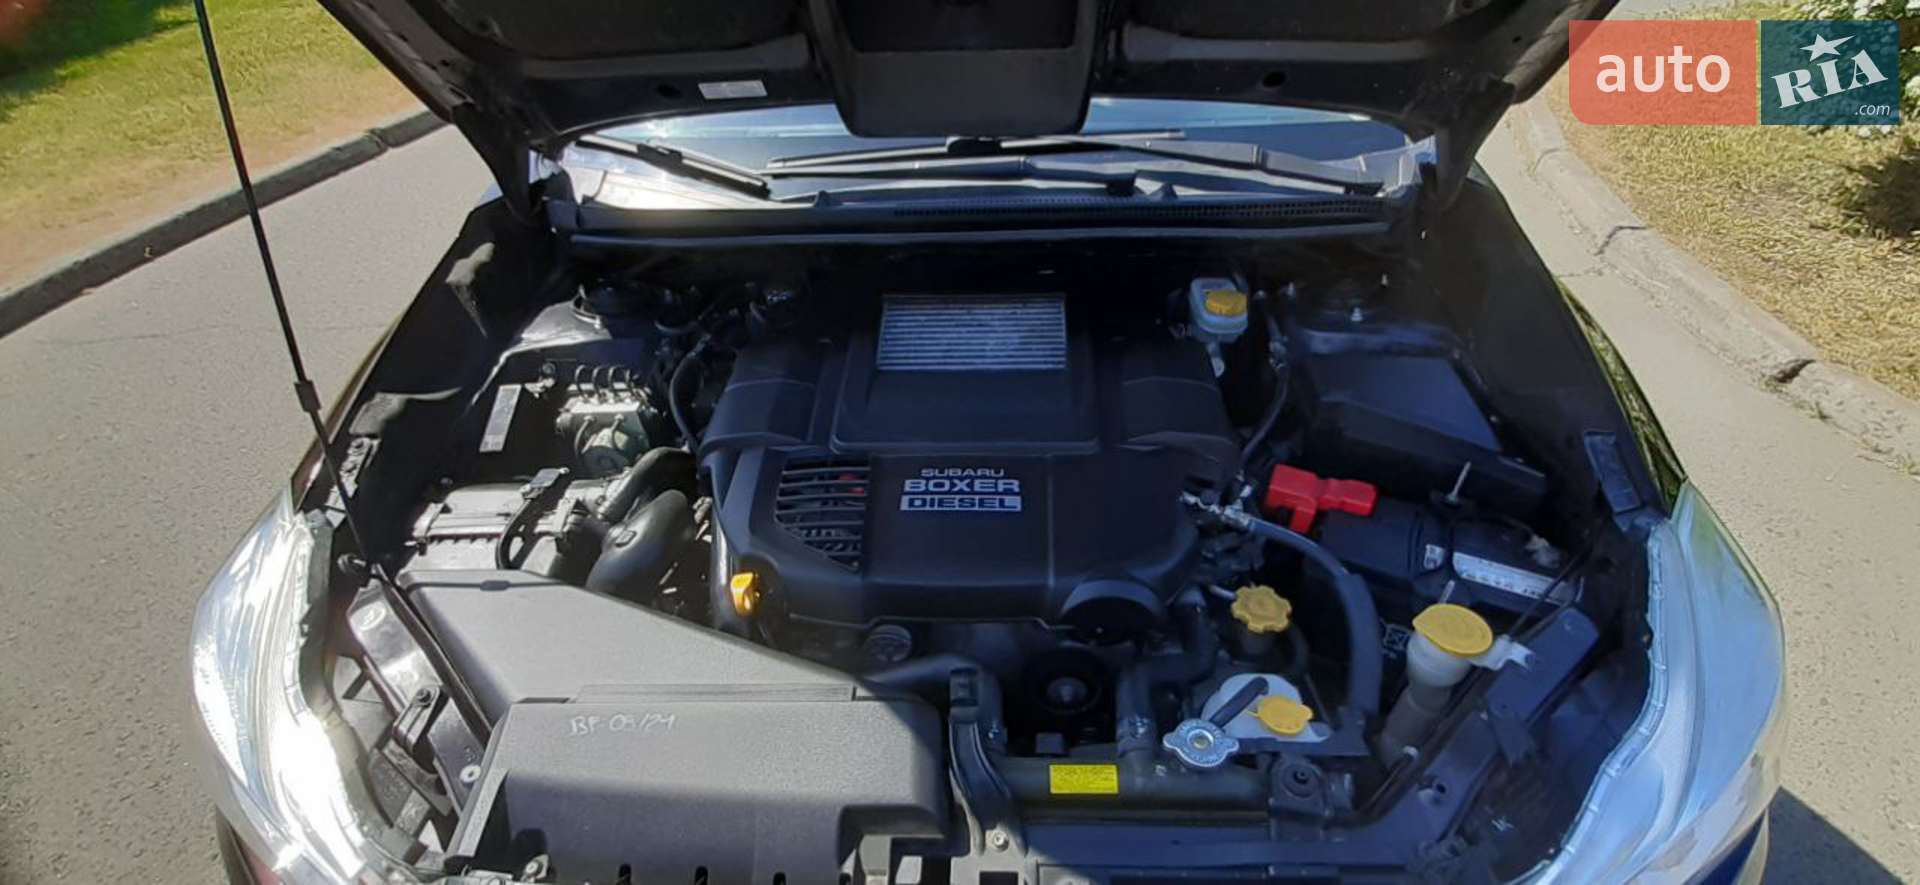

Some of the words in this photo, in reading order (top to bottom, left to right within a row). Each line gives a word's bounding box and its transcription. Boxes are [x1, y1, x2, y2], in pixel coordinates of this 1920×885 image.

[921, 467, 1005, 477] SUBARU
[904, 479, 1020, 492] BOXER
[907, 496, 1018, 509] DIESEL
